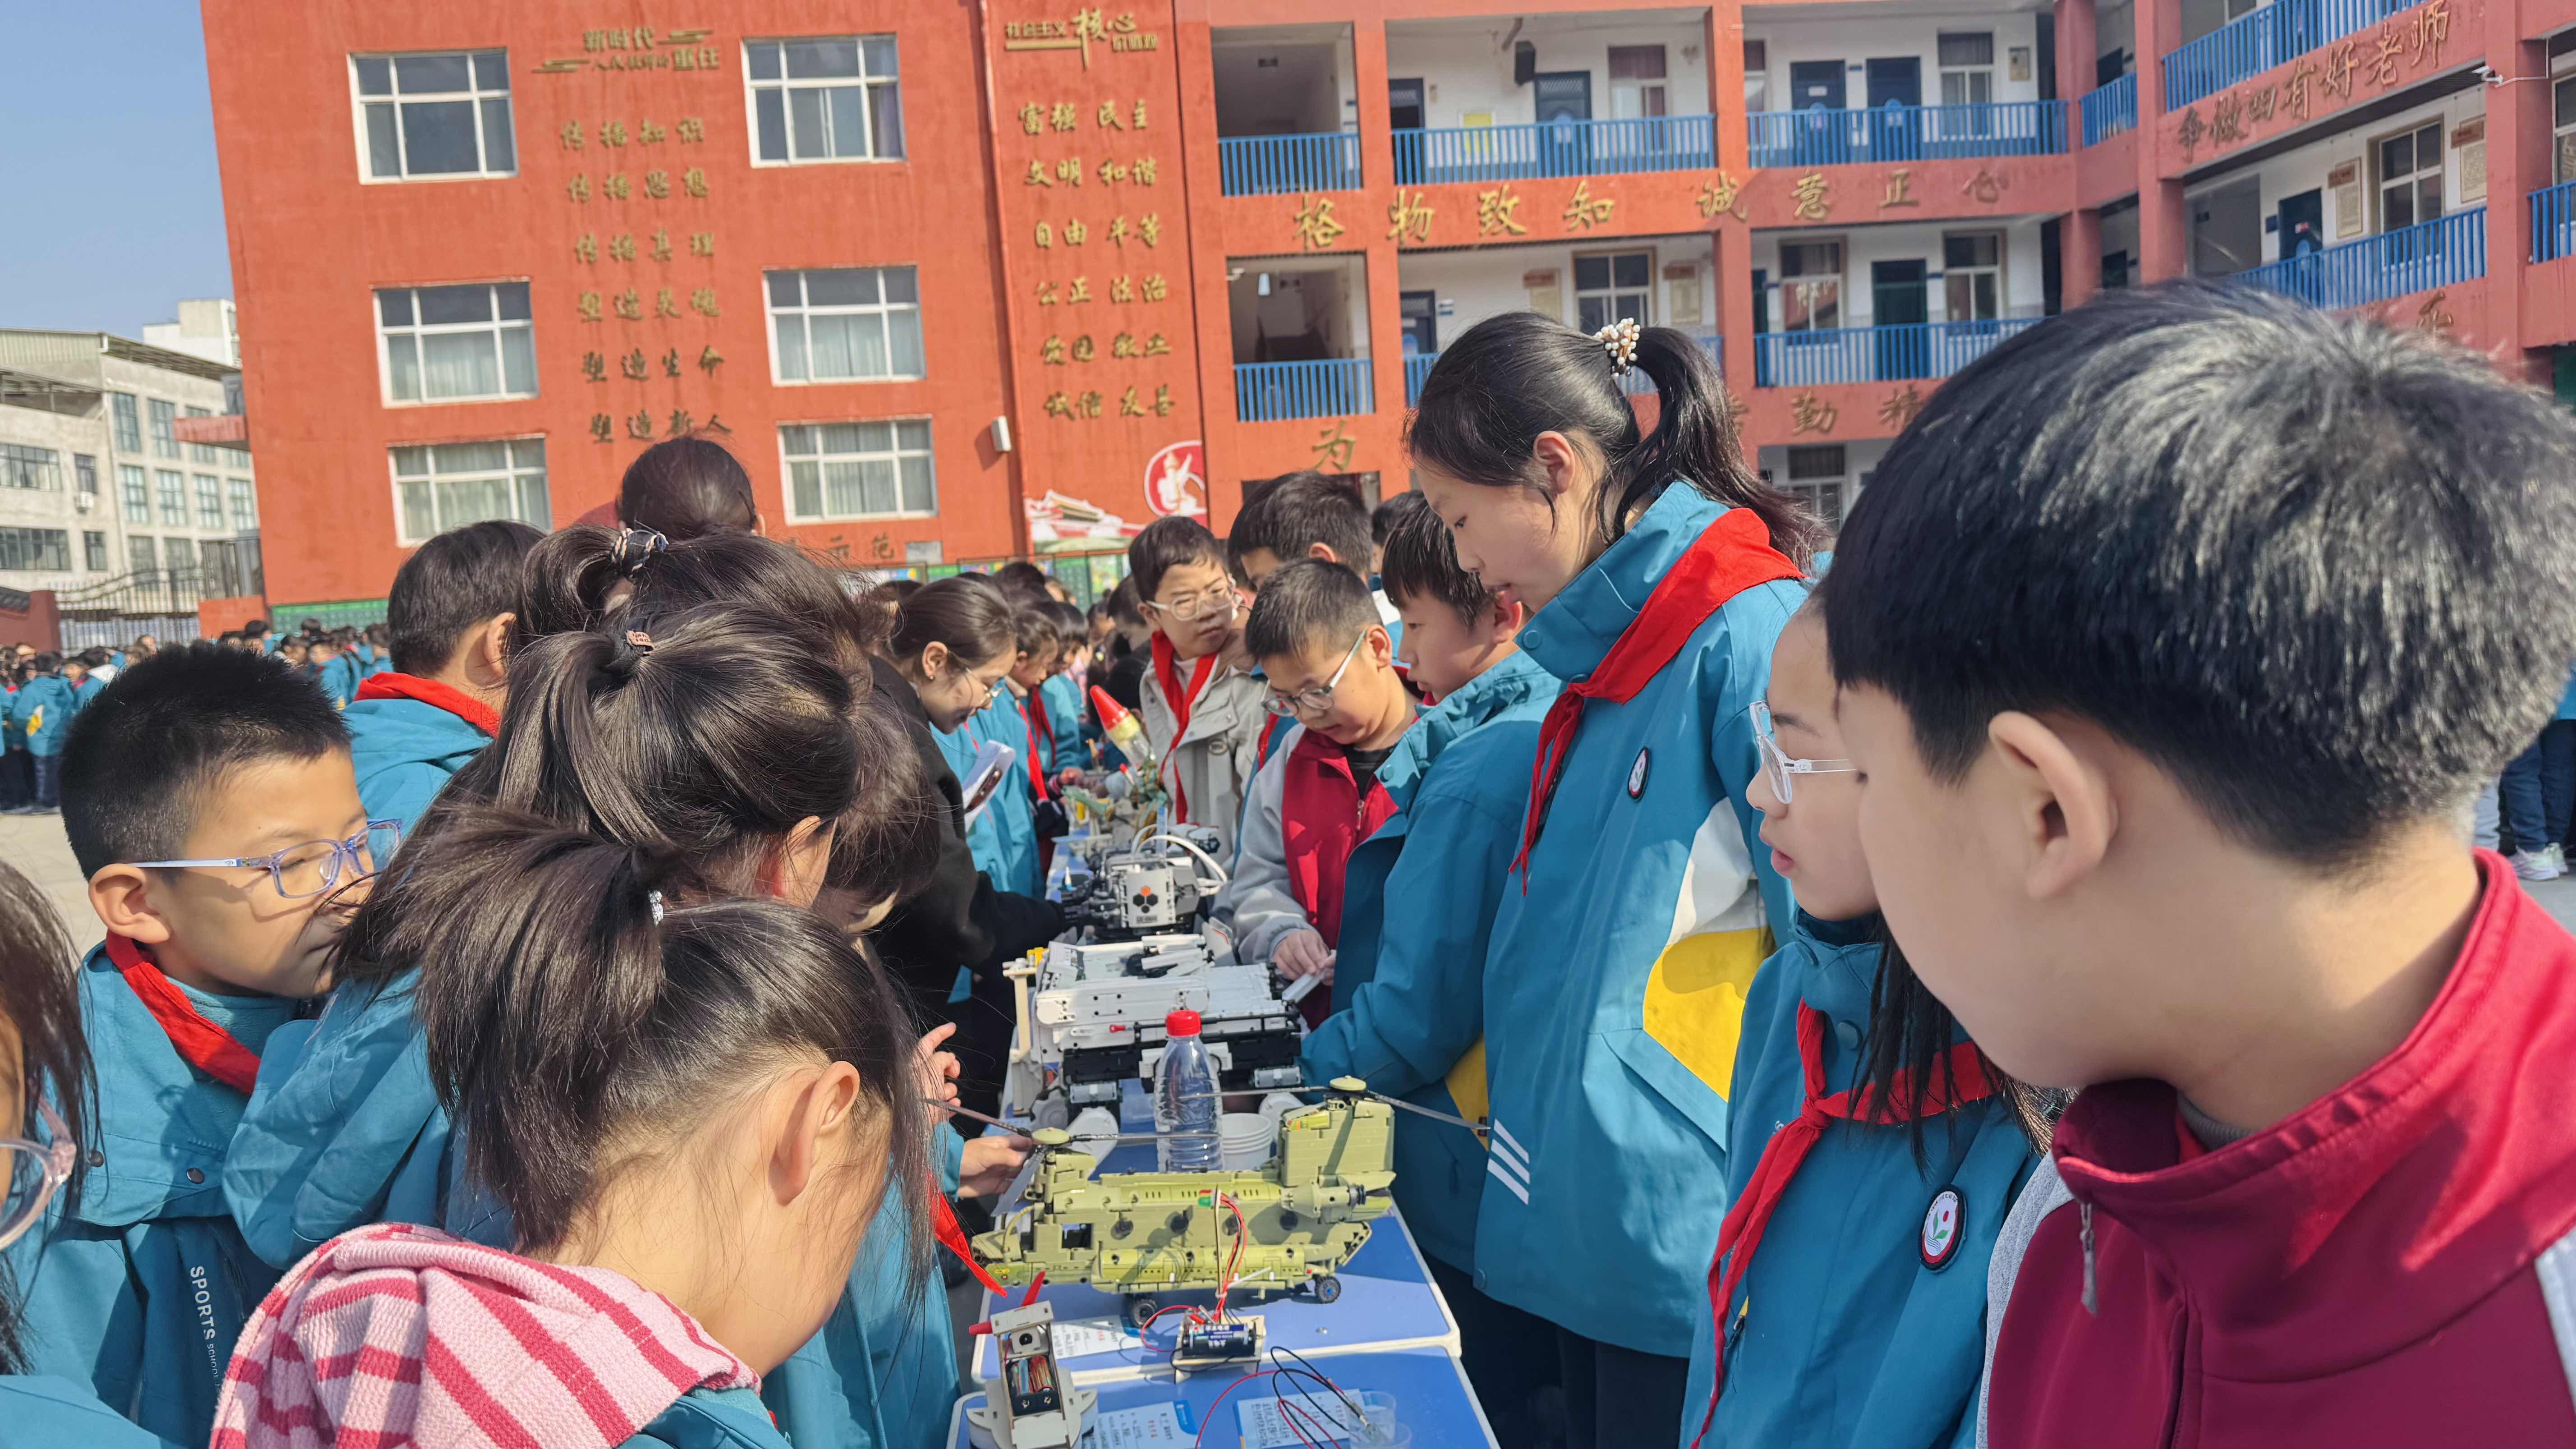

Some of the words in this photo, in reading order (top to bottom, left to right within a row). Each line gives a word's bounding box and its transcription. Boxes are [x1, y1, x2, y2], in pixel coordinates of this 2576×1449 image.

[2177, 2, 2450, 163] 争做四有好老师
[1019, 102, 1077, 135] 富强
[1097, 98, 1149, 130] 民主
[1025, 156, 1081, 187] 文明
[1097, 157, 1157, 187] 和谐
[1293, 179, 1616, 249] 格物致知
[1696, 167, 2010, 222] 诚意正心
[575, 227, 715, 264] 传播真理
[1035, 218, 1087, 249] 自由
[1107, 212, 1161, 248] 平等
[1035, 276, 1092, 306] 公正
[1110, 274, 1167, 304] 法治
[582, 345, 724, 382] 塑造生命
[1040, 334, 1095, 365] 爱国
[1112, 331, 1172, 359] 敬业
[1044, 390, 1103, 421] 诚信
[1119, 384, 1176, 418] 友善
[589, 409, 732, 444] 塑造新人
[1311, 419, 1357, 472] 为
[190, 1265, 216, 1340] SPORTS
